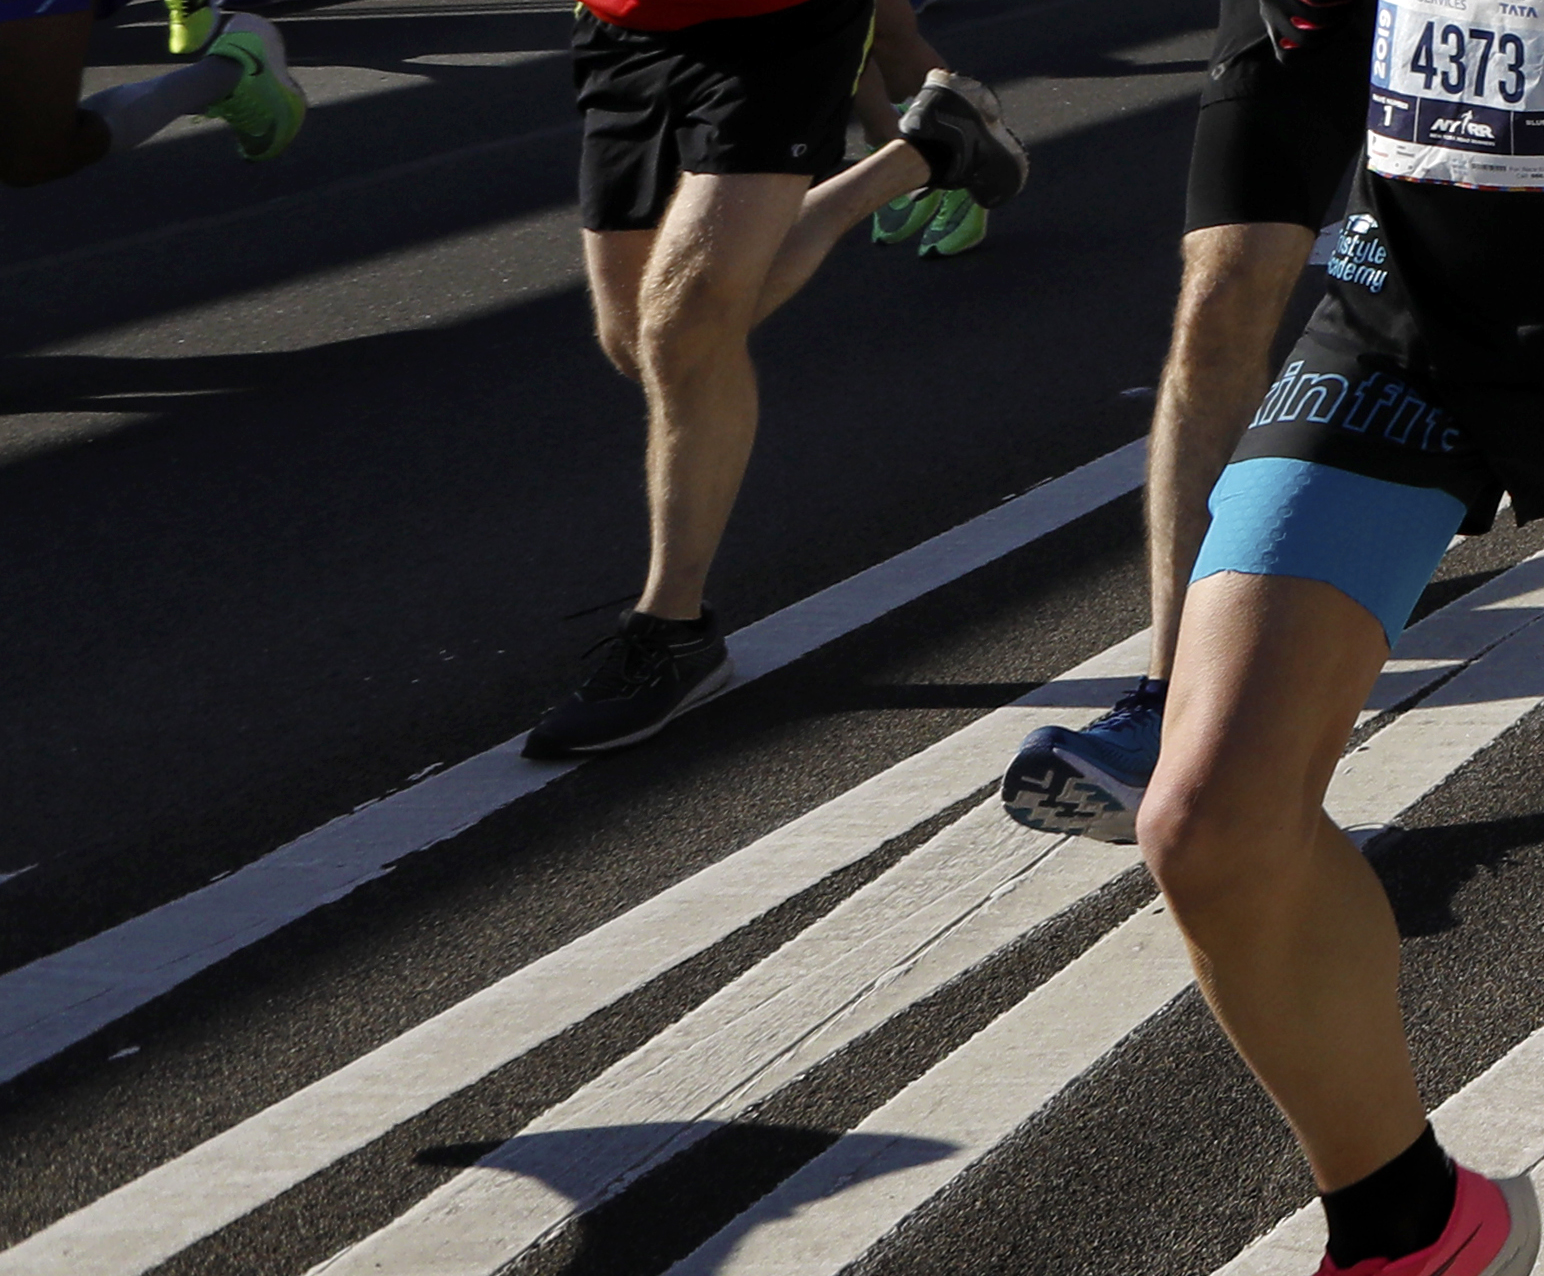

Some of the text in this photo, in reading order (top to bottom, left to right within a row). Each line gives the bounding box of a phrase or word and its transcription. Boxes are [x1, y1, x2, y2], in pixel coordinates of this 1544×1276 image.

[1498, 2, 1539, 19] TATA
[1371, 9, 1392, 80] 2019
[1410, 20, 1525, 104] 4373
[1382, 105, 1392, 127] 1
